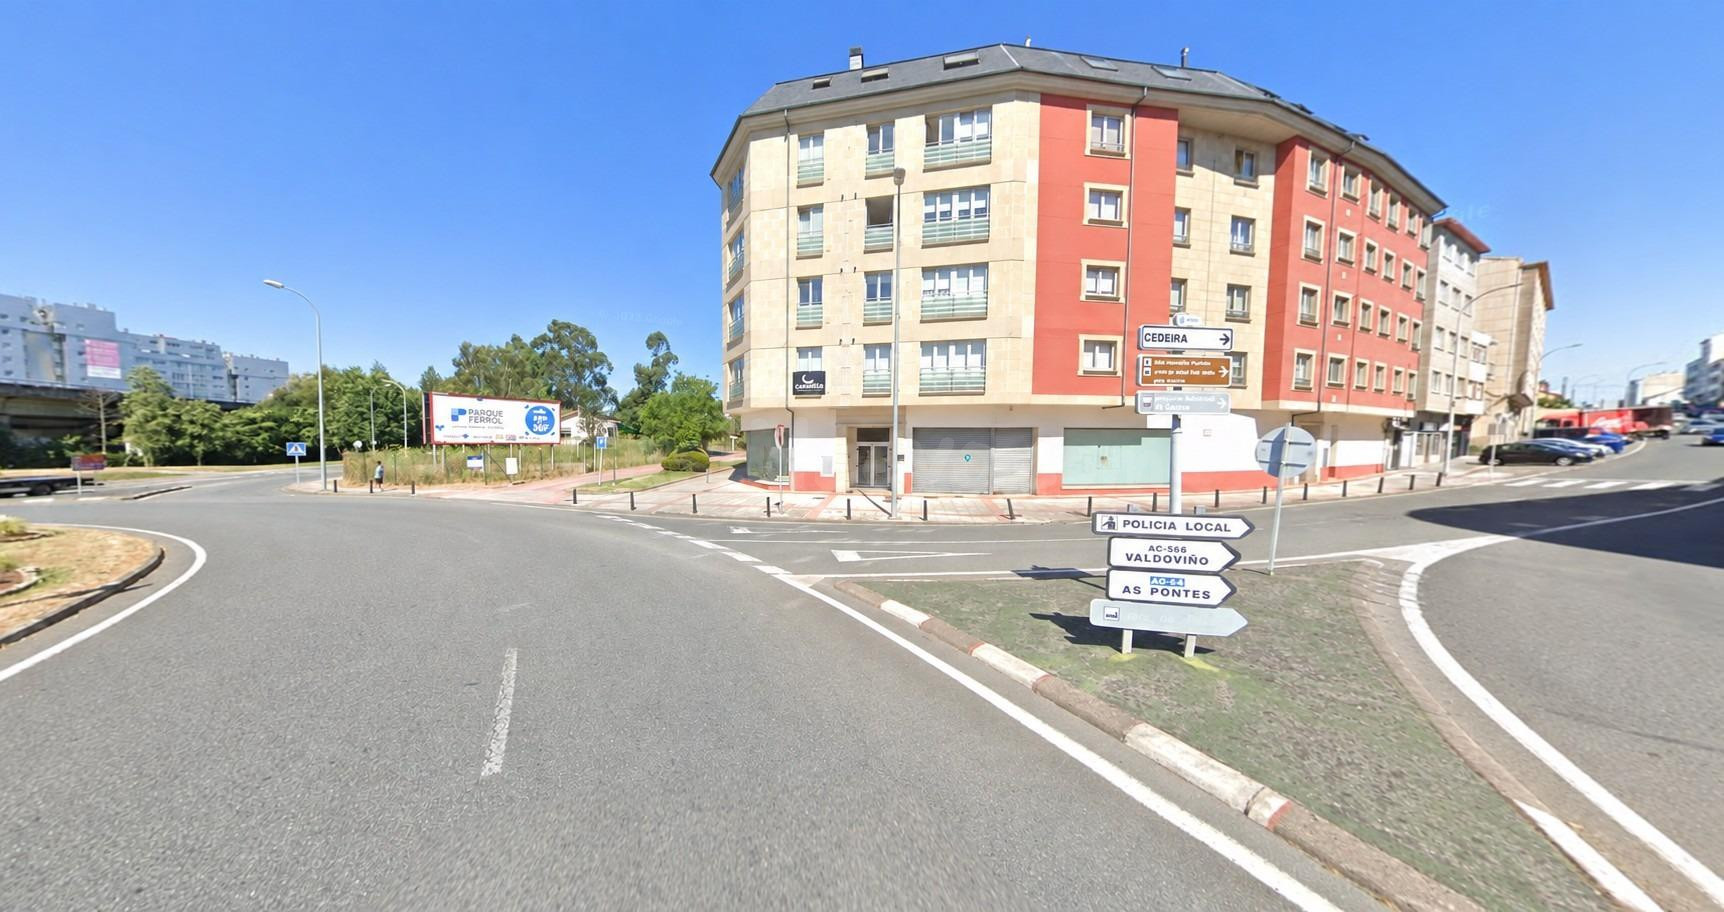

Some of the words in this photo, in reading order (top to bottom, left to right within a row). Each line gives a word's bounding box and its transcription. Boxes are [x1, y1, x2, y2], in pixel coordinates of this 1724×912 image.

[1144, 333, 1188, 343] CEDEIRA
[468, 408, 503, 417] PARQUE
[468, 416, 503, 424] FERROL
[1122, 519, 1177, 531] POLICIA
[1186, 522, 1232, 533] LOCAL
[1125, 553, 1209, 566] VALDOVIÑO
[1122, 585, 1141, 595] AS
[1150, 588, 1211, 600] PONTES
